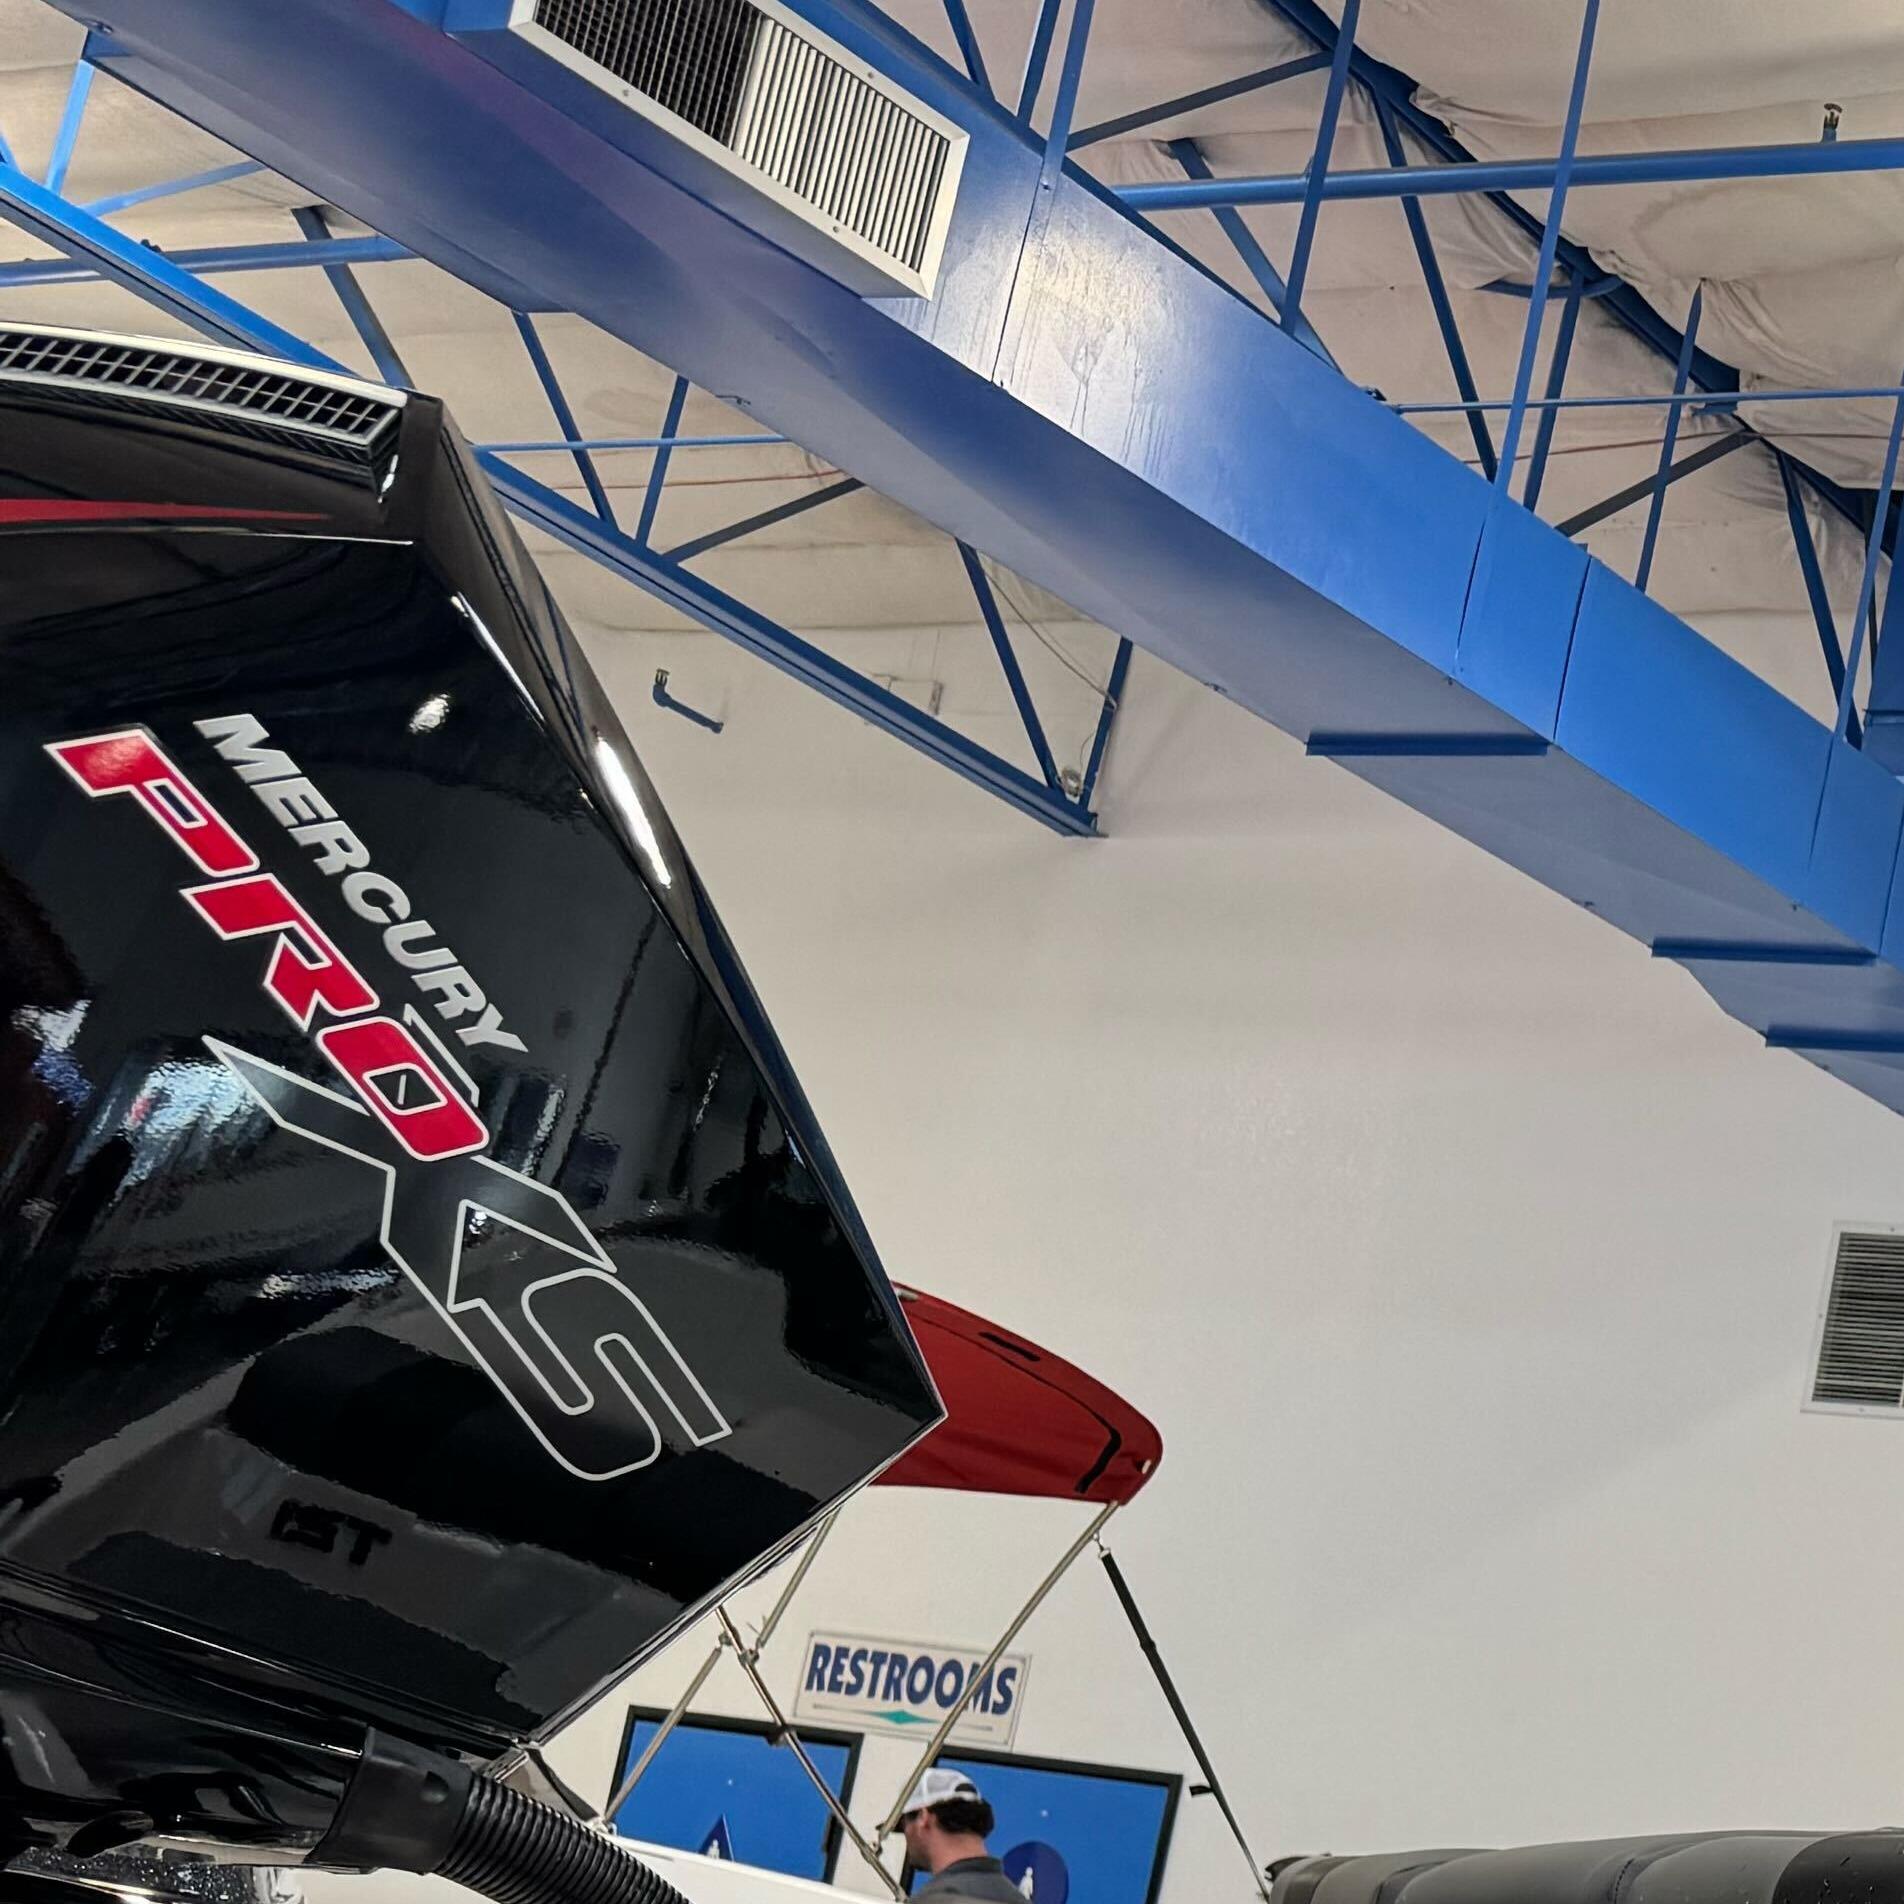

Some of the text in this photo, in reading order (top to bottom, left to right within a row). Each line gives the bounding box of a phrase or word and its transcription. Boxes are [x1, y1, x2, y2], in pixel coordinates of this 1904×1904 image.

[43, 723, 489, 1163] PRO
[191, 713, 527, 1053] MERCURY
[804, 1642, 1018, 1717] RESTROOMS
